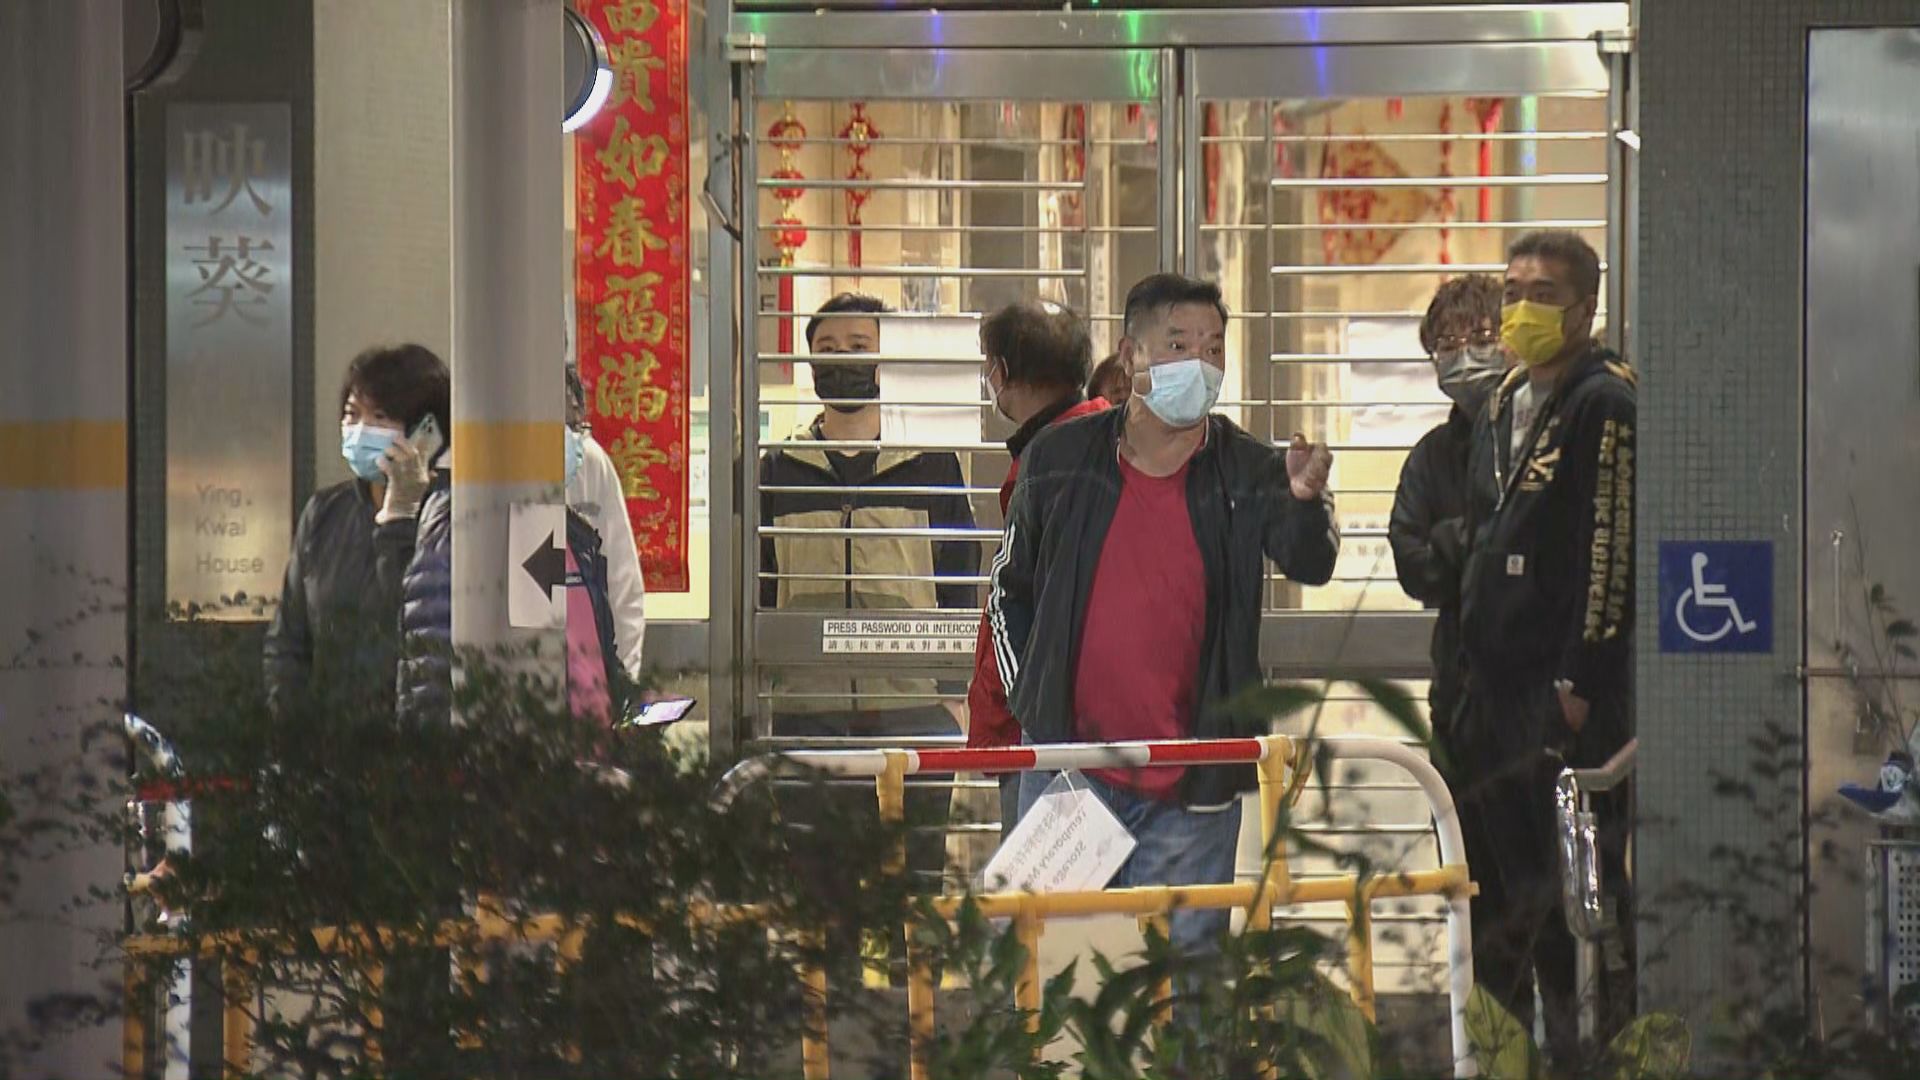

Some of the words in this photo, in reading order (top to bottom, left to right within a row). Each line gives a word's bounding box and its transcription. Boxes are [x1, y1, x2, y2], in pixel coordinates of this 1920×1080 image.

[184, 124, 275, 328] 映葵
[195, 552, 264, 573] House
[827, 622, 857, 633] PRESS
[861, 622, 911, 633] PASSWORD
[915, 622, 929, 633] OR
